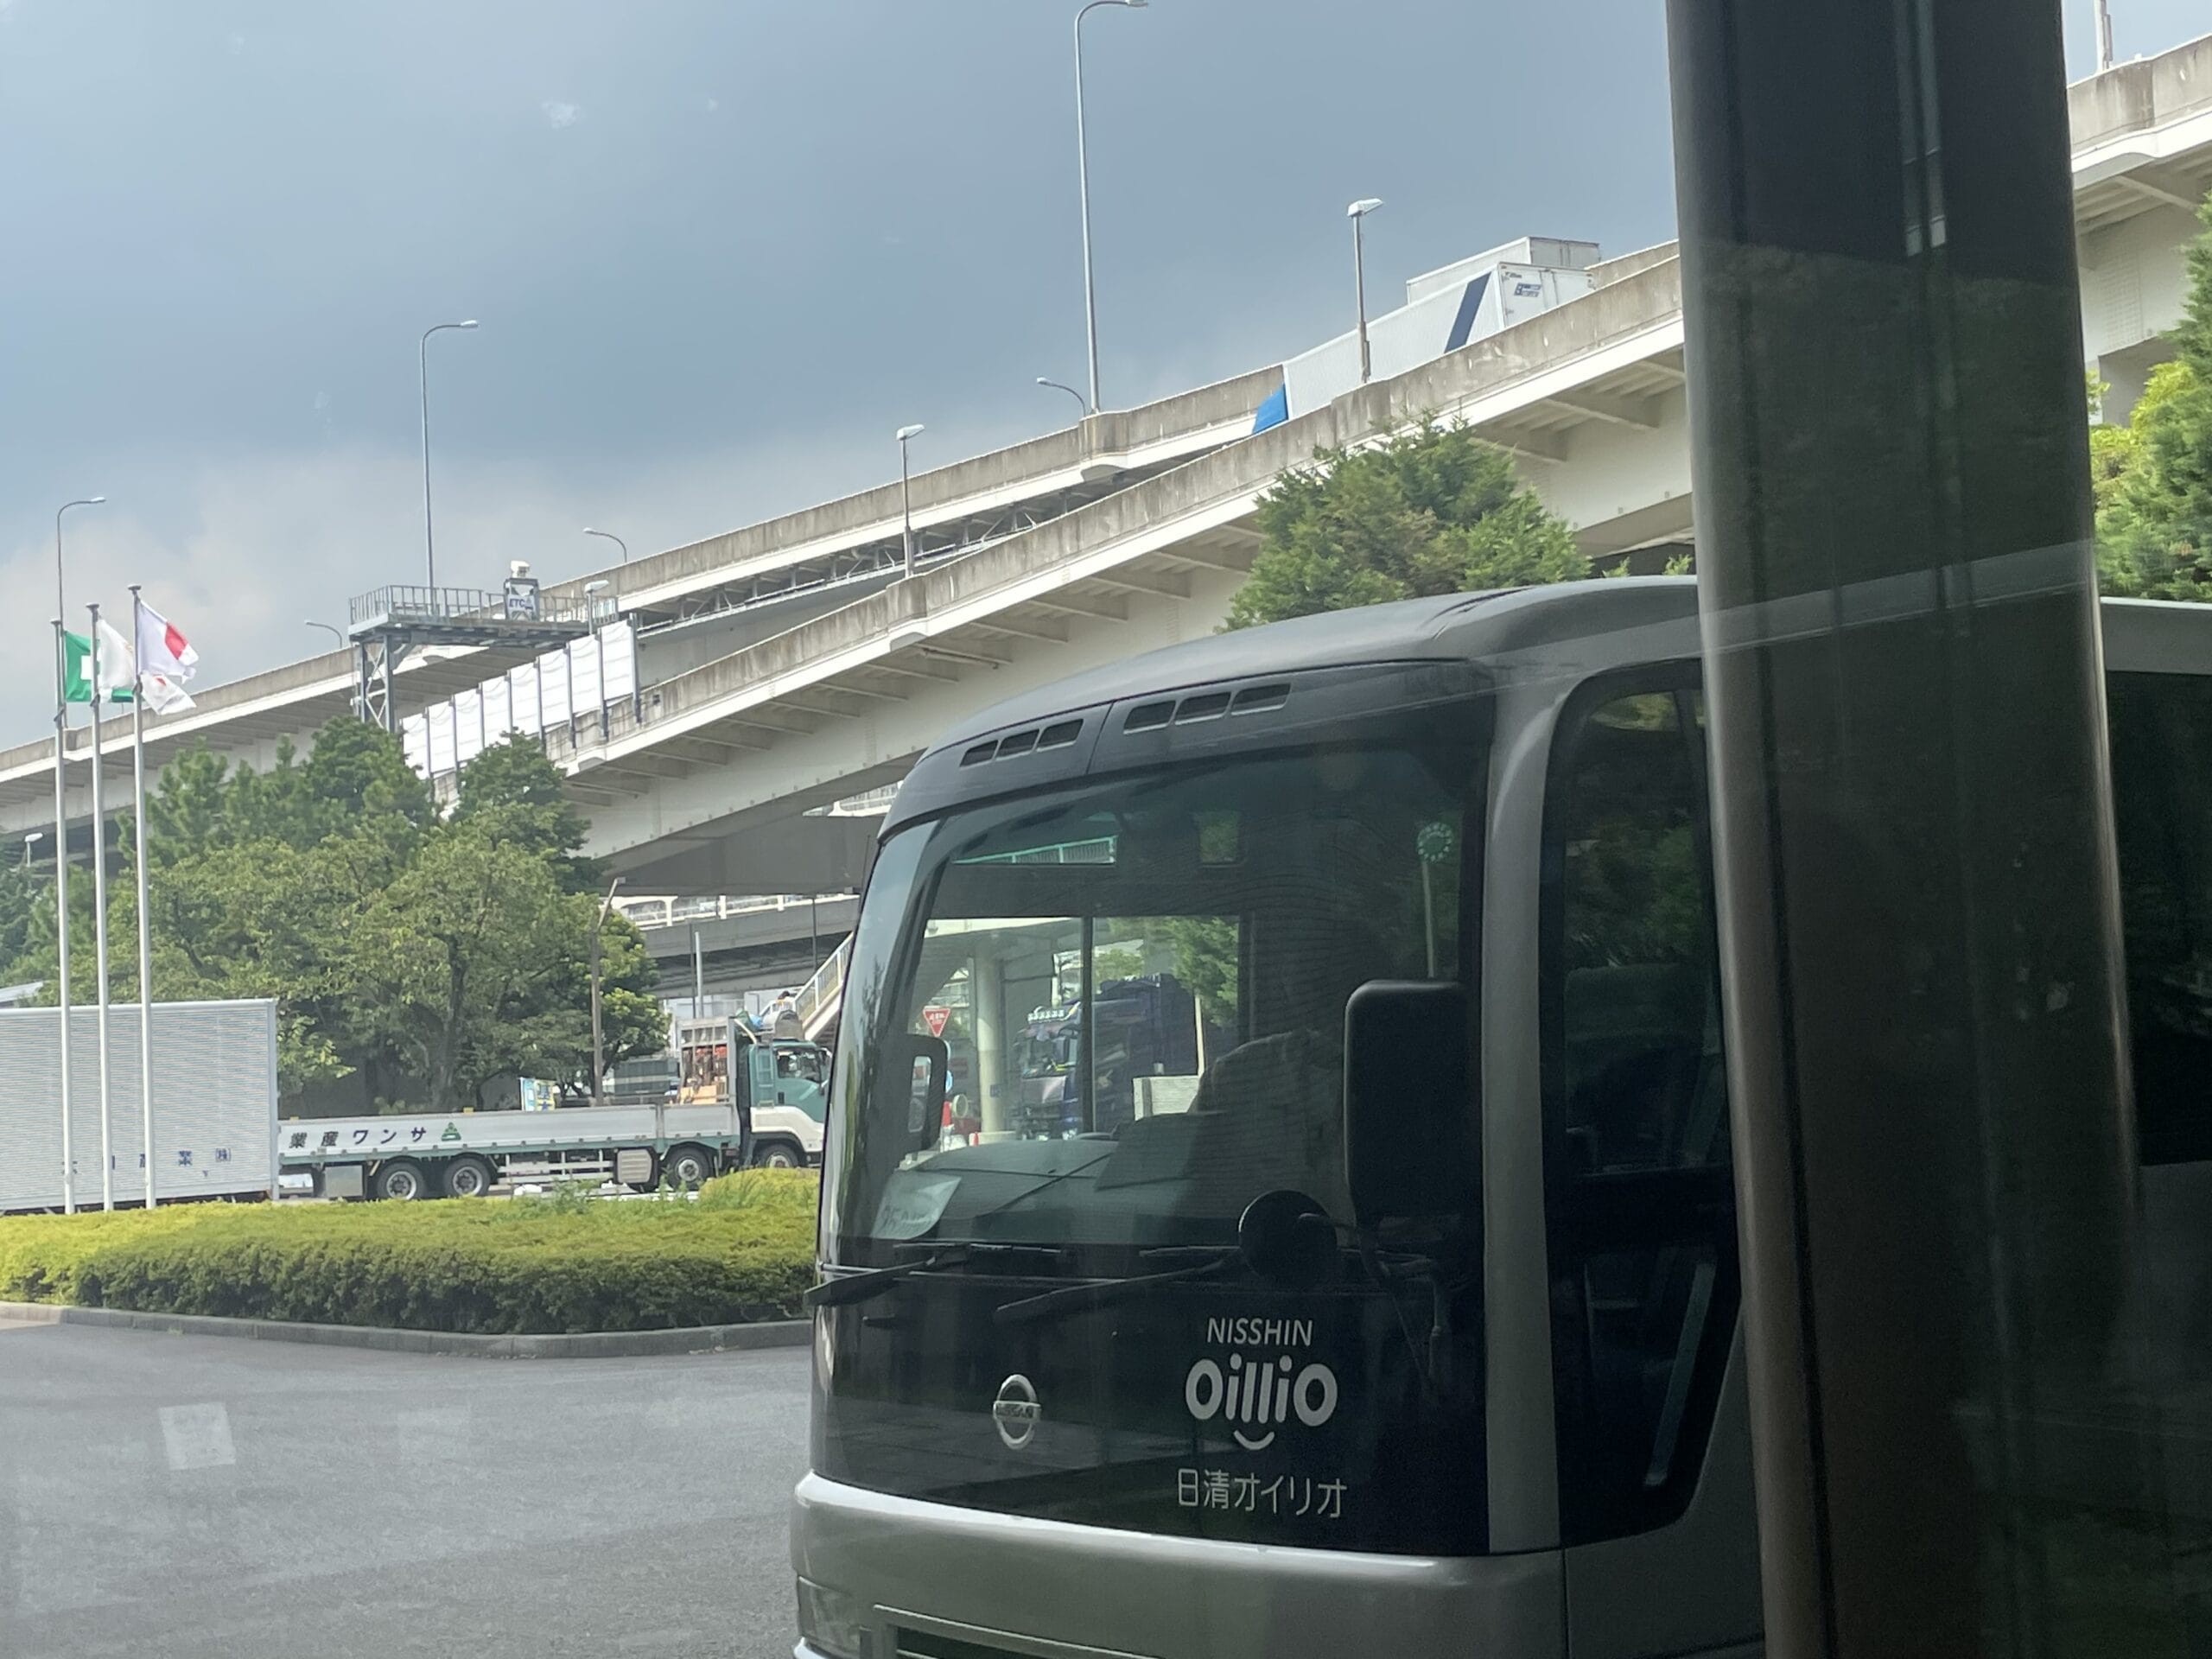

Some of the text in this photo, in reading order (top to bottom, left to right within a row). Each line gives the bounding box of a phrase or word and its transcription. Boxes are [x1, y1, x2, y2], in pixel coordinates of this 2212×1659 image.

[1207, 1317, 1313, 1347] NISSHIN
[1178, 1468, 1348, 1518] 日清オイリオ
